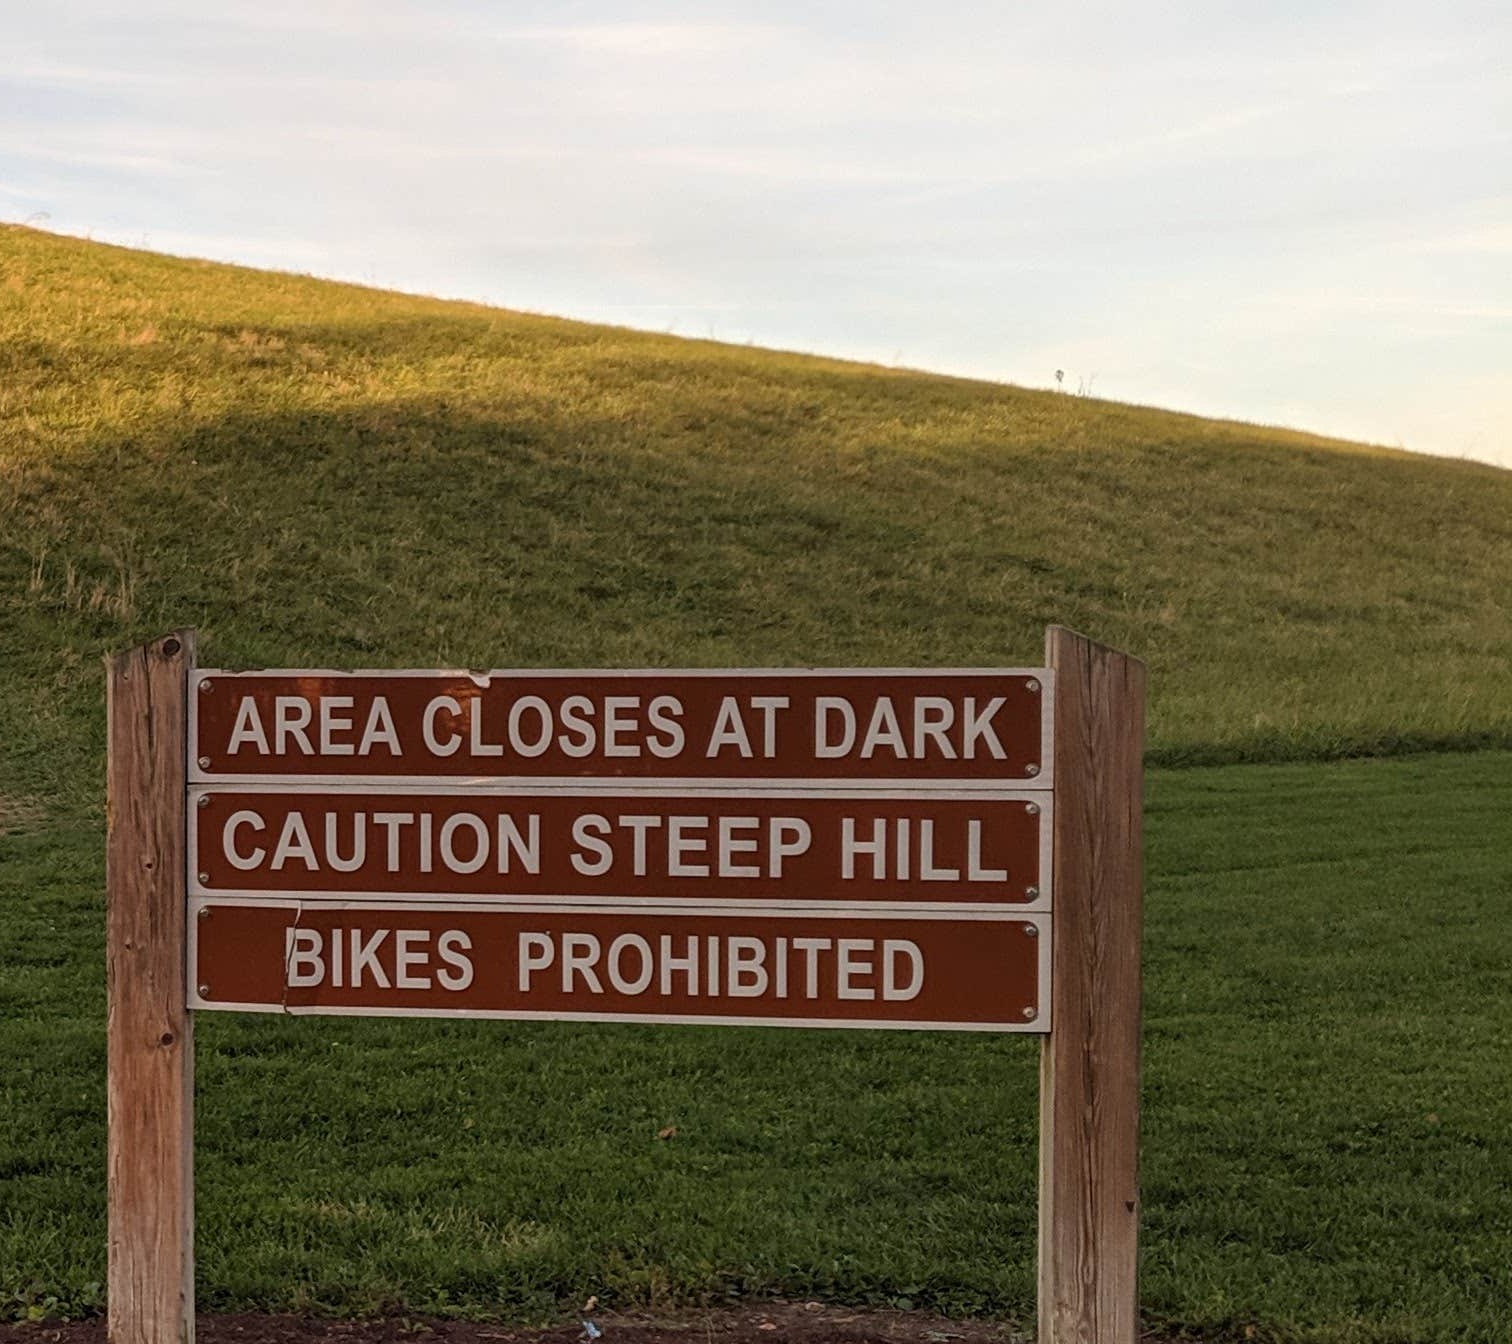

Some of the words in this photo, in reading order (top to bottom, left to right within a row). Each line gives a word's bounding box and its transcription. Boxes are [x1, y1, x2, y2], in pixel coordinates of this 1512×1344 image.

[227, 696, 403, 756] AREA
[422, 695, 685, 758] CLOSES
[706, 696, 789, 758] AT
[815, 696, 1008, 760] DARK
[222, 810, 540, 874] CAUTION
[570, 813, 812, 878] STEEP
[841, 817, 1008, 882] HILL
[285, 926, 474, 991] BIKES
[518, 932, 924, 1001] PROHIBITED
